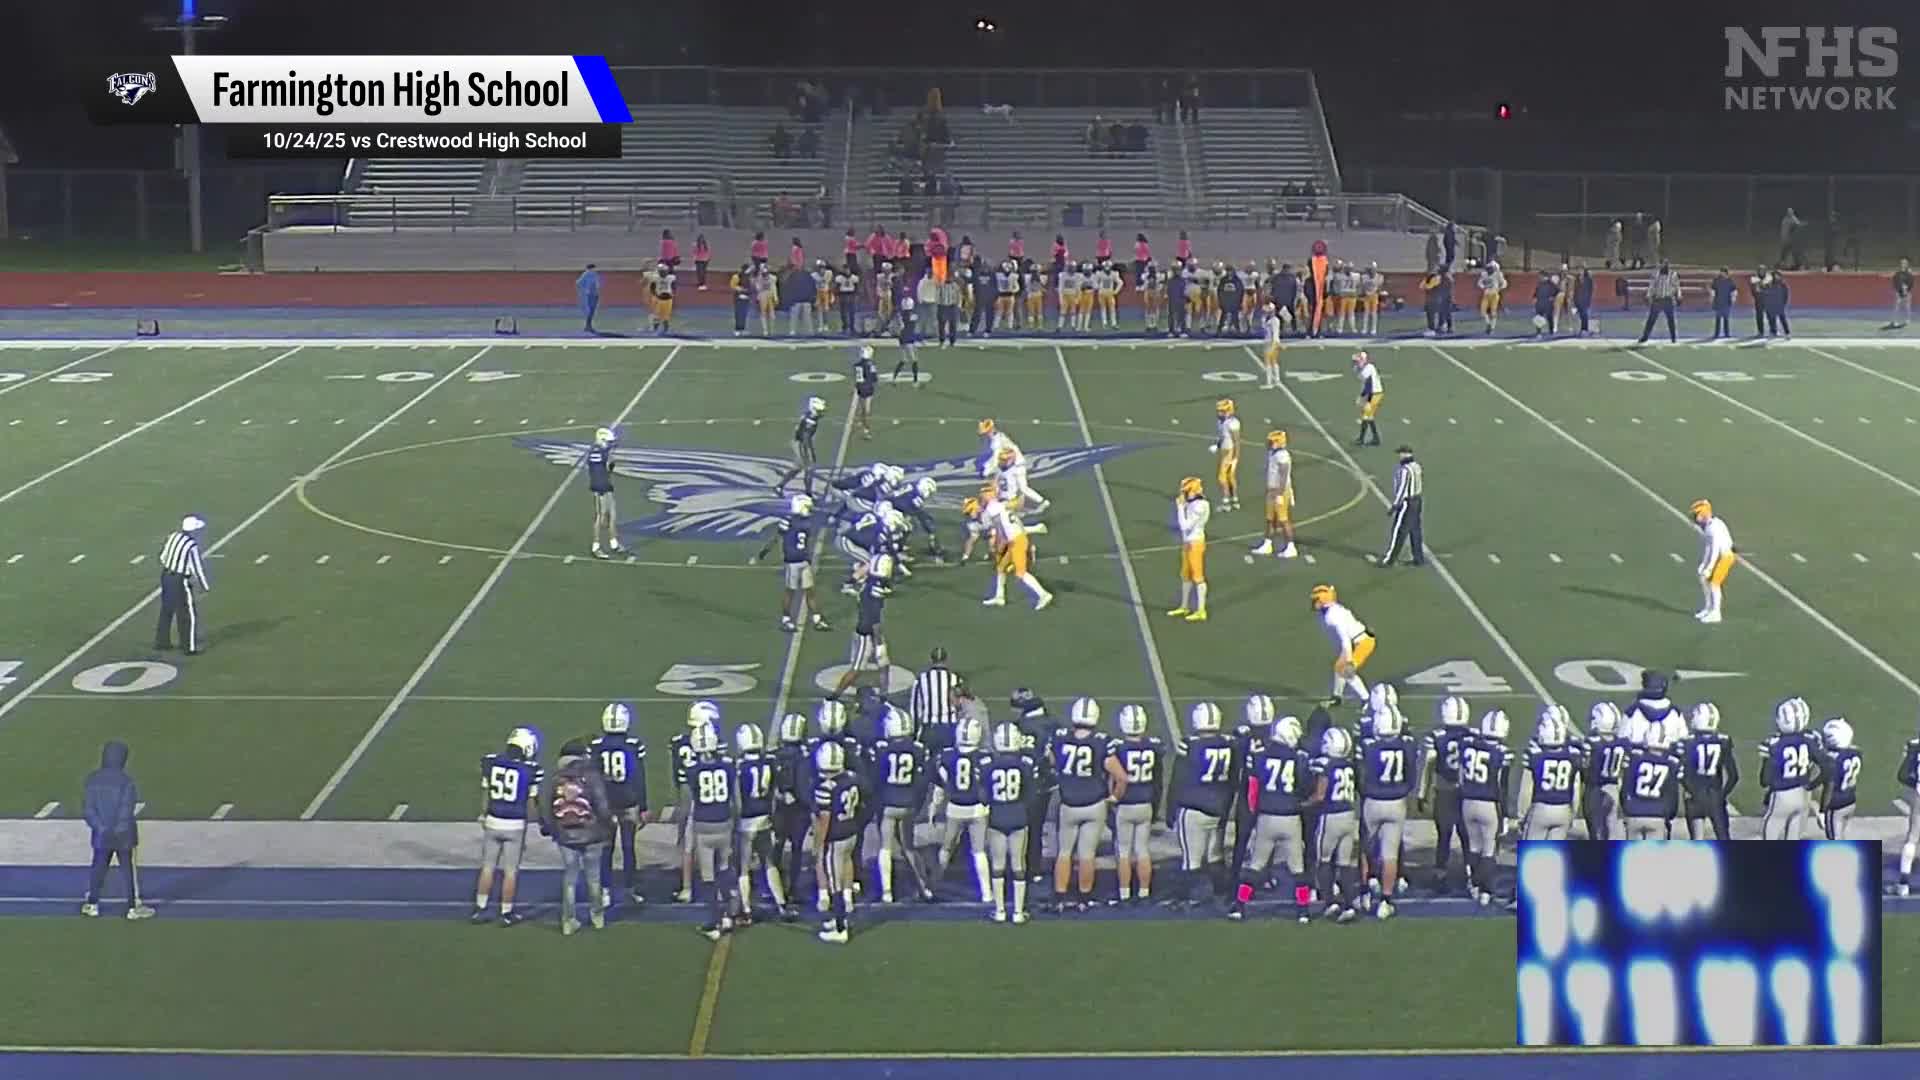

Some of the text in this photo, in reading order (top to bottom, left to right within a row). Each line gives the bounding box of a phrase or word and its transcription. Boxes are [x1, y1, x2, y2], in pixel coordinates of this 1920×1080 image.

[601, 751, 626, 782] 18
[887, 753, 913, 784] 12
[1062, 744, 1092, 776] 72
[1127, 750, 1155, 782] 52
[1202, 748, 1231, 781] 77
[1265, 758, 1295, 793] 74
[1379, 750, 1404, 782] 71
[1464, 748, 1490, 783] 35
[1541, 760, 1572, 791] 58
[1696, 743, 1721, 776] 17
[491, 766, 520, 802] 59
[698, 769, 728, 804] 88
[991, 768, 1021, 801] 28
[1635, 761, 1669, 798] 27
